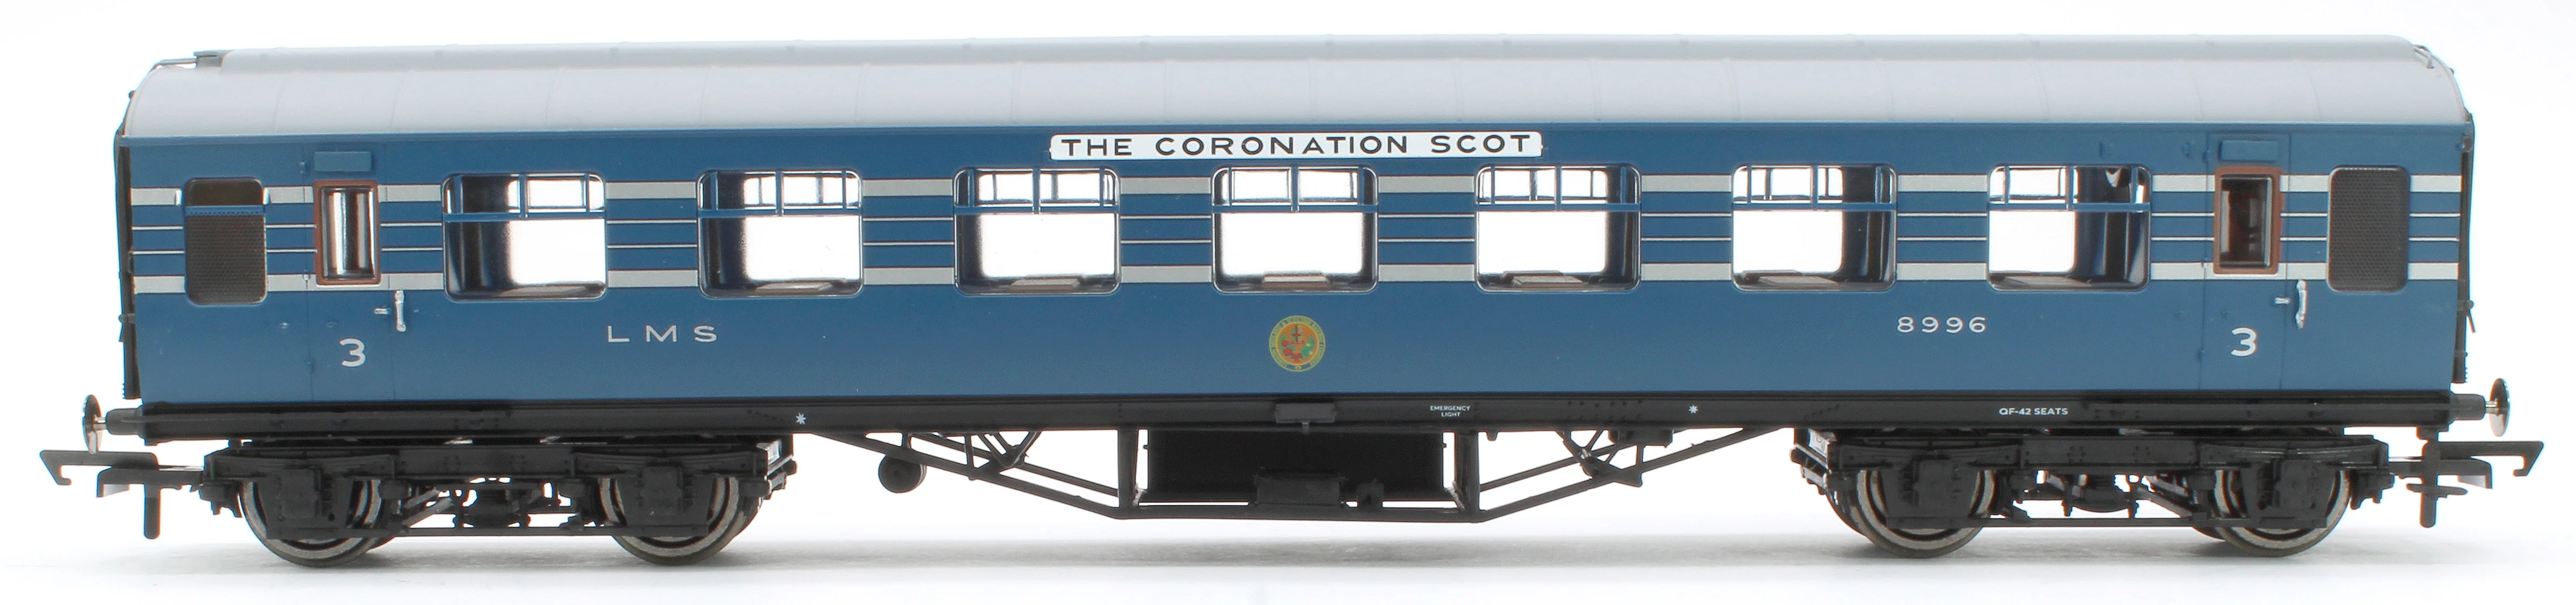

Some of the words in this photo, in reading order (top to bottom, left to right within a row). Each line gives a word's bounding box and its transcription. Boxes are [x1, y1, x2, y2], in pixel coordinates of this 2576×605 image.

[1061, 138, 1132, 156] THE
[1155, 135, 1407, 156] CORONATION
[1430, 134, 1530, 153] SCOT
[1897, 316, 1986, 334] 8996
[339, 338, 366, 367] 3
[2231, 327, 2258, 357] 3
[2034, 407, 2069, 415] SEATS
